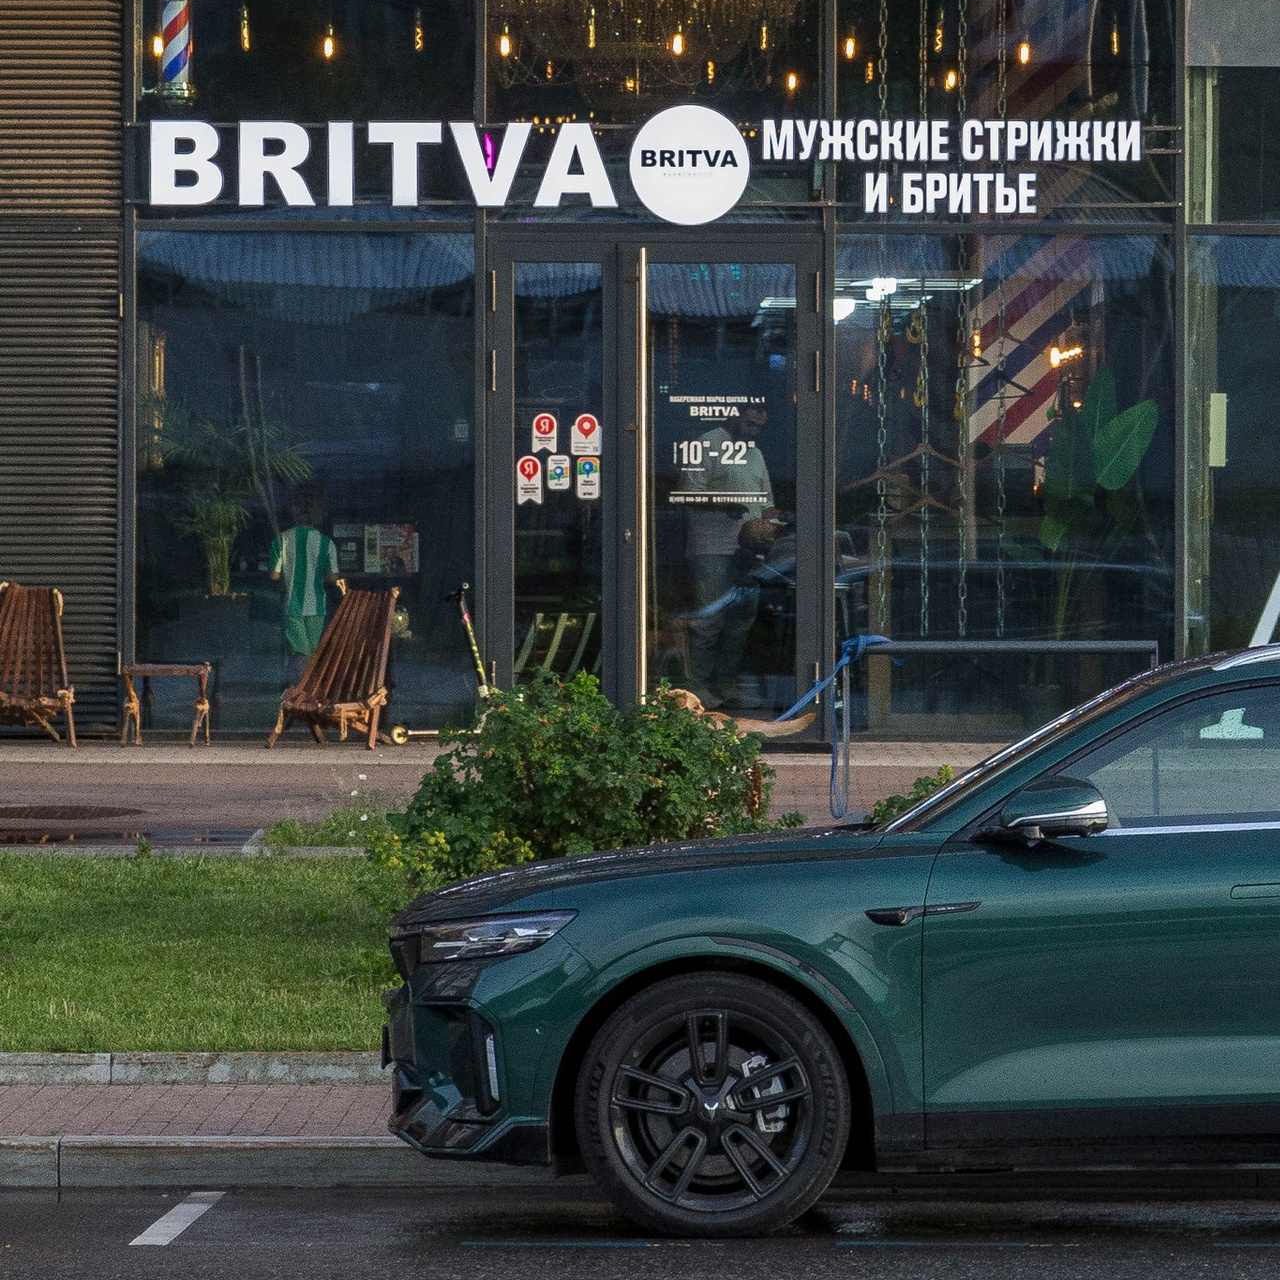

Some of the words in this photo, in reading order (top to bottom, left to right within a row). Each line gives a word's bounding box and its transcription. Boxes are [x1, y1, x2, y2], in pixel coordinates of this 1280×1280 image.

[641, 149, 739, 168] BRITVA
[761, 119, 950, 161] МУЖСКИЕ
[962, 120, 1142, 162] СТРИЖКИ
[149, 120, 618, 207] BRITVA
[864, 172, 888, 213] И
[902, 172, 1038, 214] БРИТЬЕ
[690, 406, 740, 417] BRITVA
